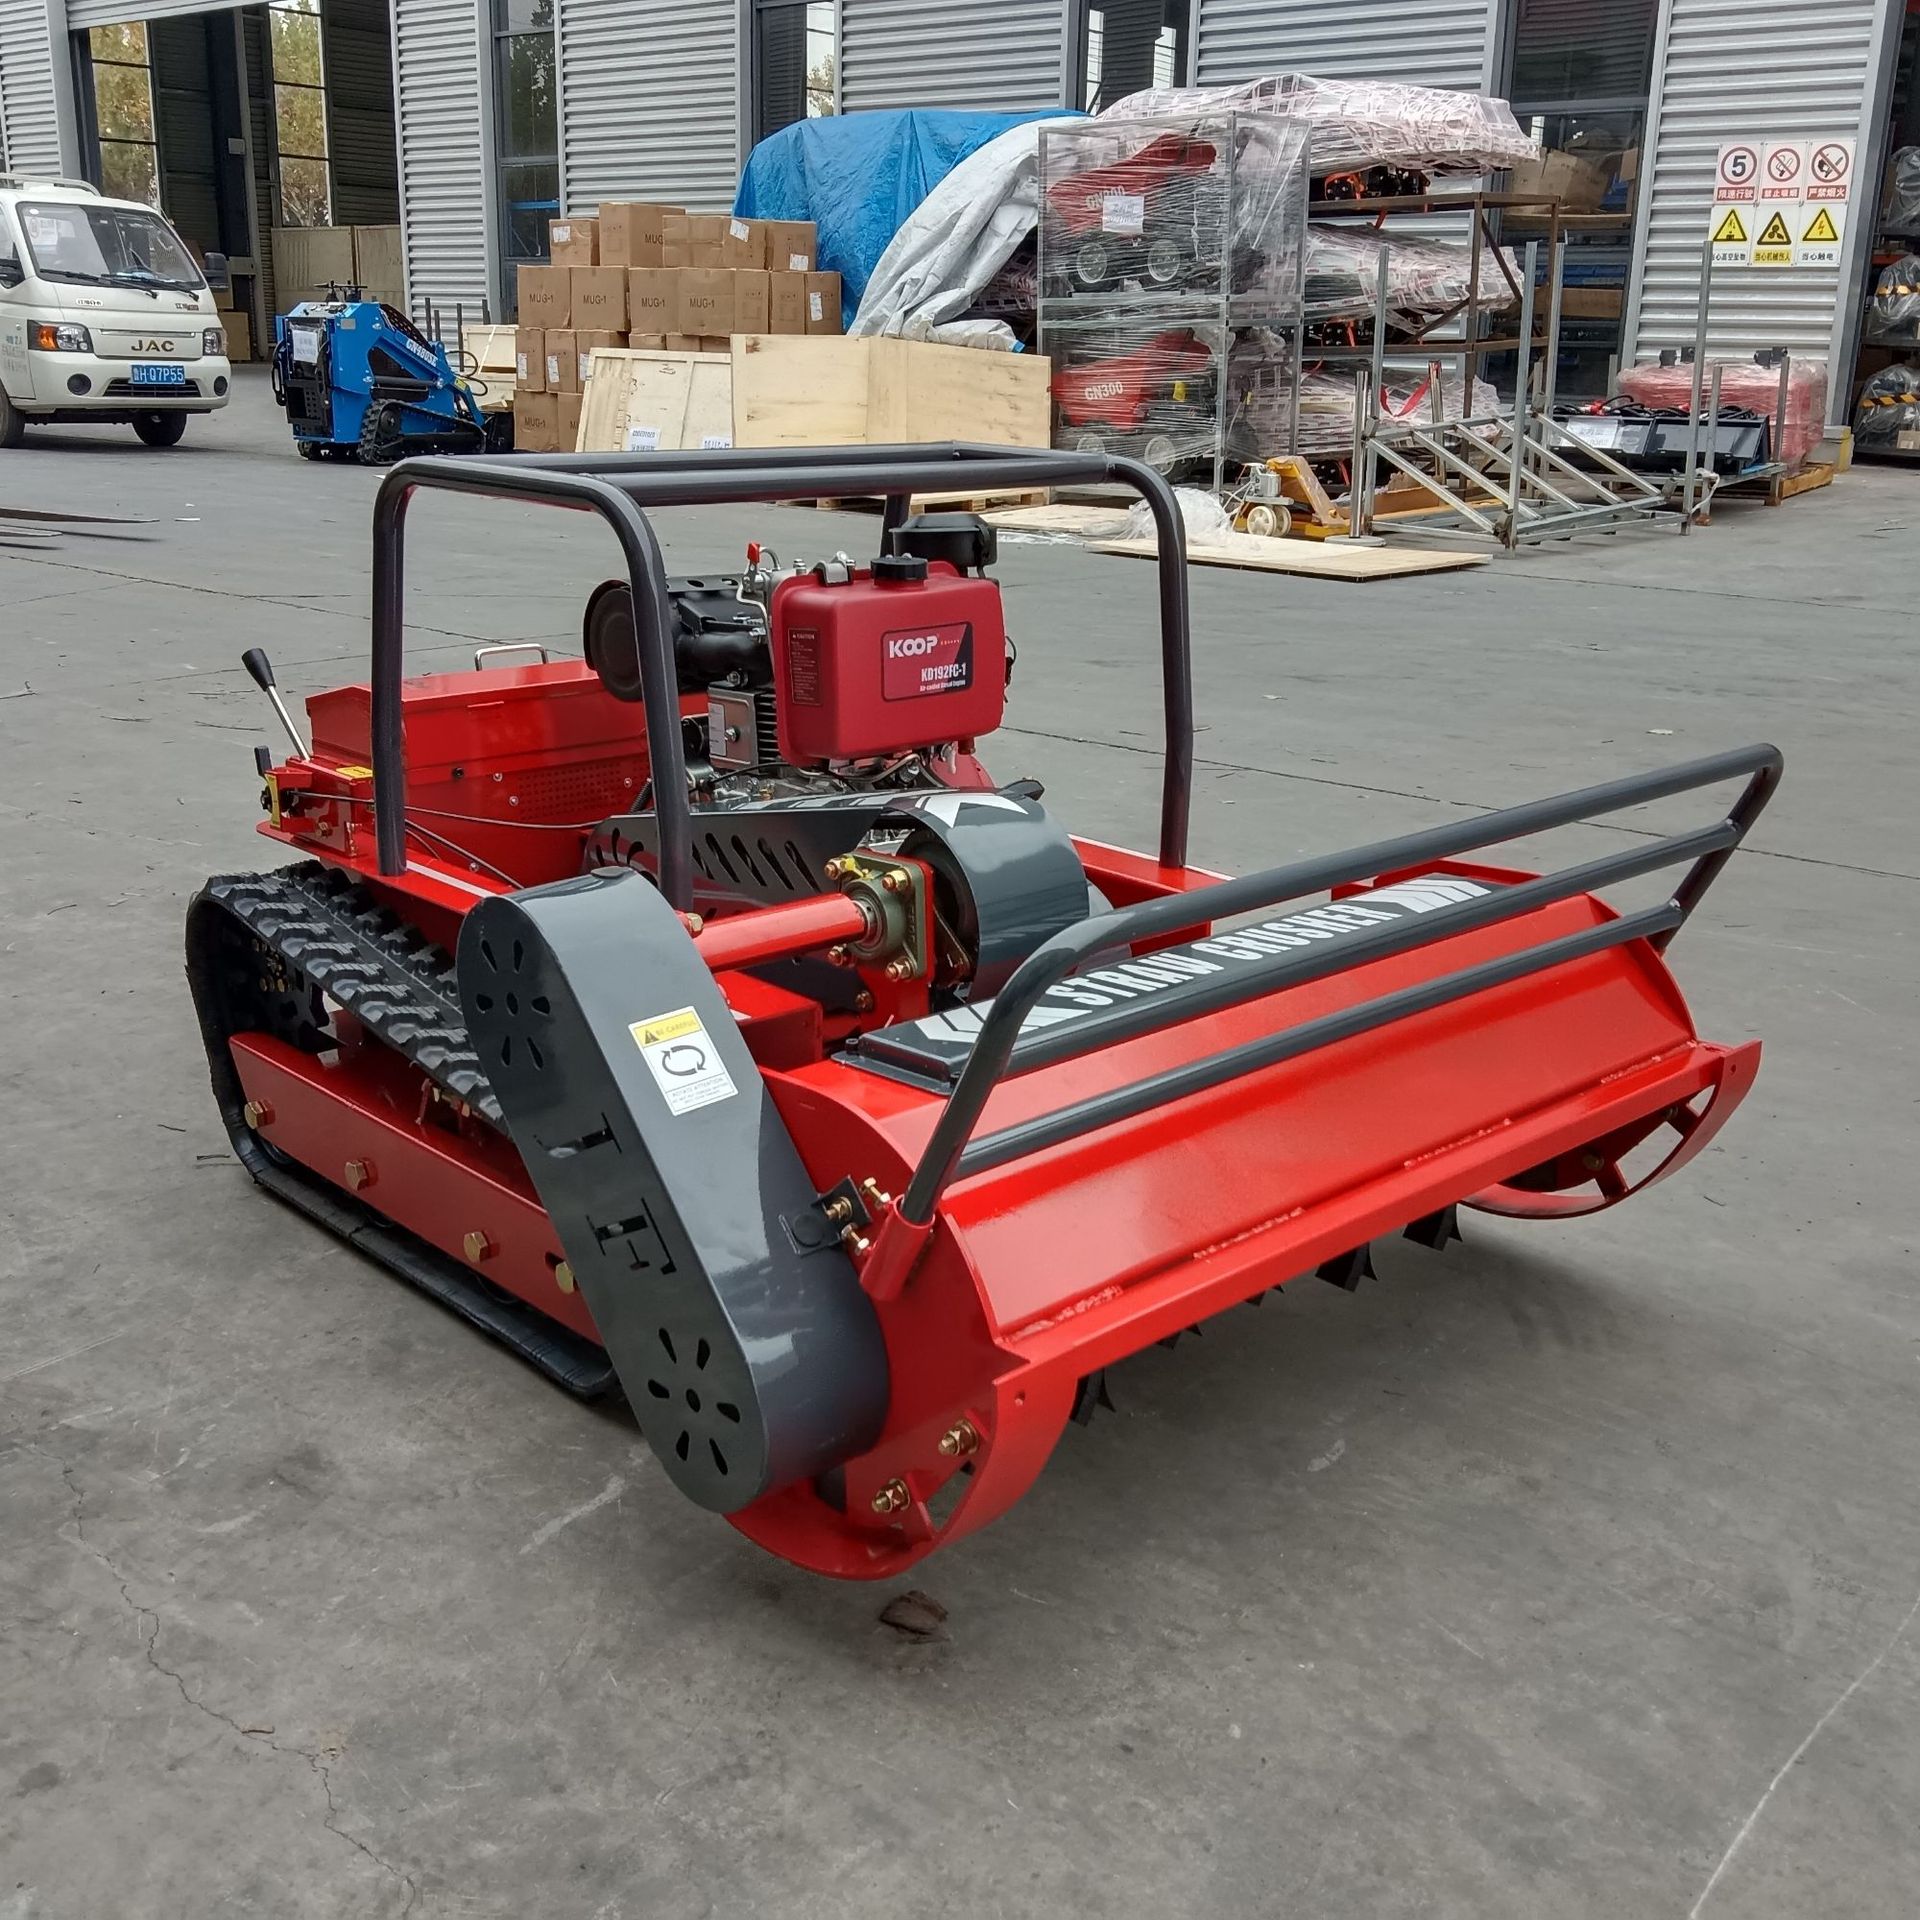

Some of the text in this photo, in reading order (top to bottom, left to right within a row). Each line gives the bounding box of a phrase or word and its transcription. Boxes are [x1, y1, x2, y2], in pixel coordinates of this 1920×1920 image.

[1731, 155, 1747, 177] 5
[1808, 187, 1846, 198] 严禁烟火
[1712, 252, 1746, 261] 心高空坠物
[529, 294, 554, 304] MUG-1
[583, 295, 607, 305] MUG-1
[641, 298, 665, 308] MUG-1
[690, 298, 715, 308] MUG-1
[131, 340, 175, 352] JAC
[1085, 381, 1124, 400] GN300
[524, 416, 546, 428] MUG-1
[889, 635, 938, 658] KOOP
[921, 662, 966, 682] KD192FC-1
[1045, 904, 1402, 1005] STRAW CRUSHER
